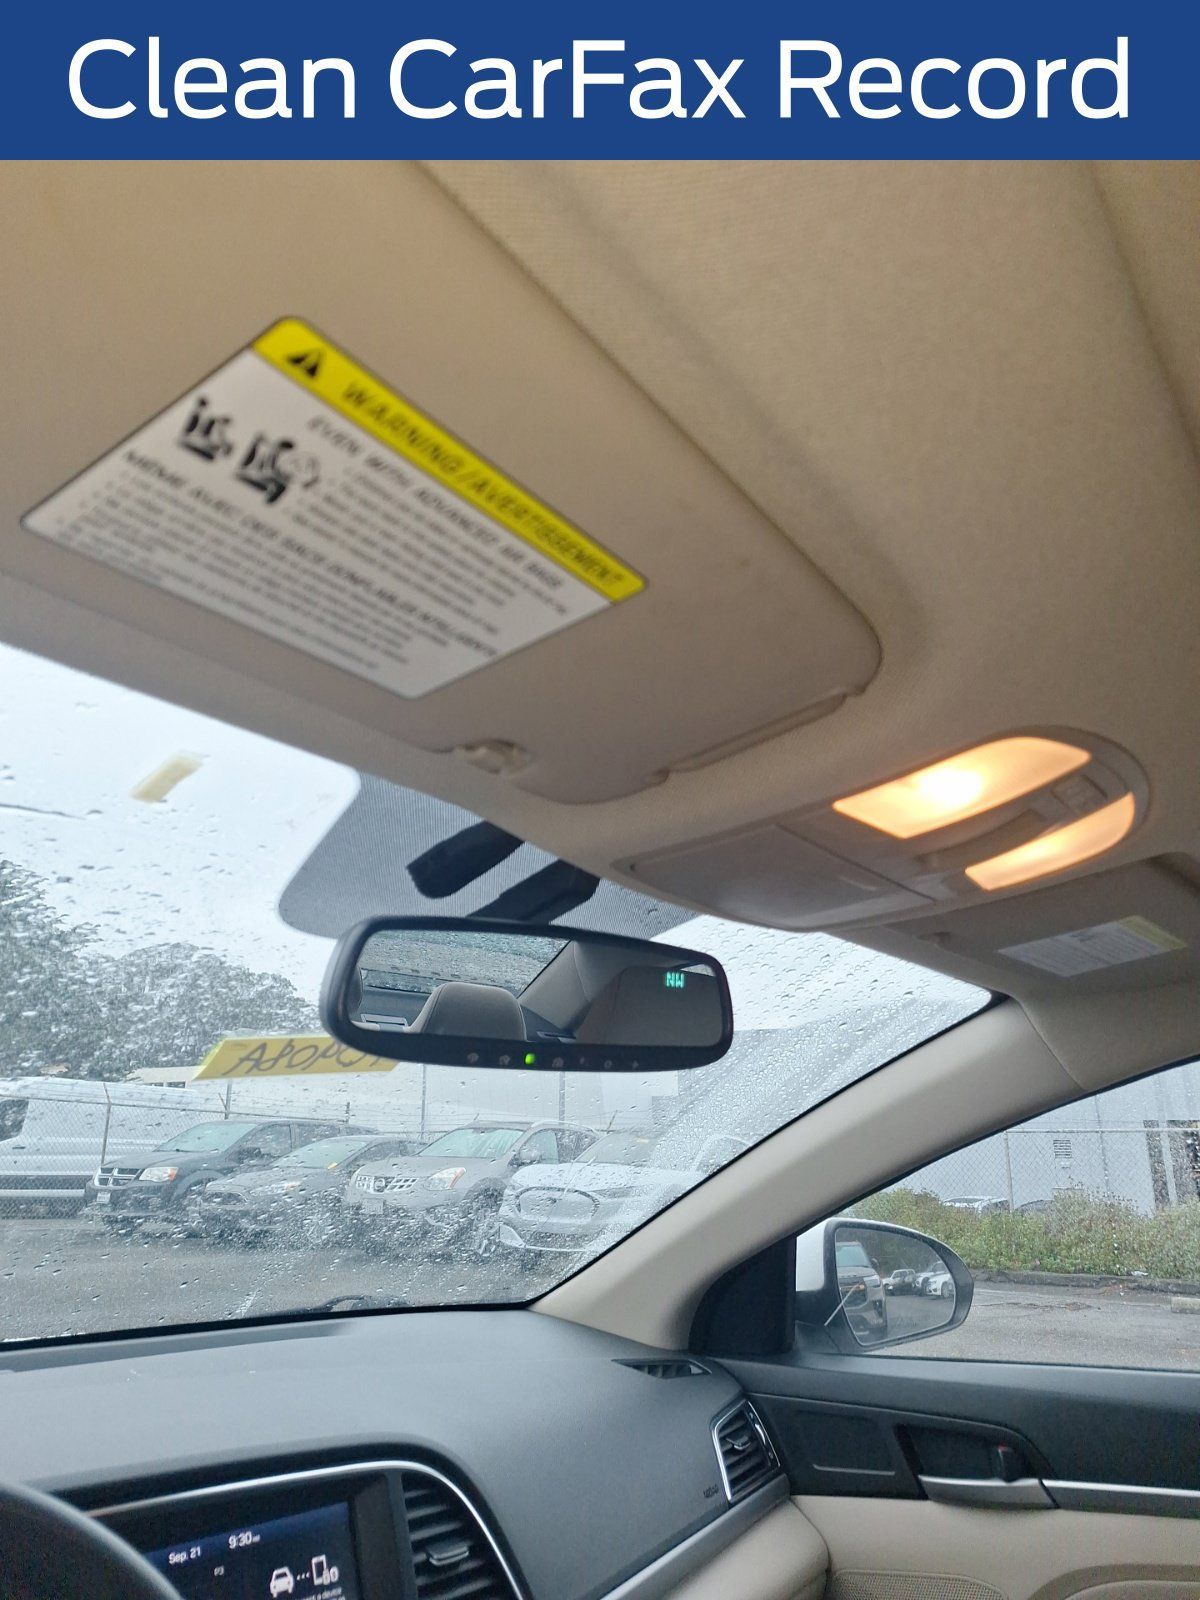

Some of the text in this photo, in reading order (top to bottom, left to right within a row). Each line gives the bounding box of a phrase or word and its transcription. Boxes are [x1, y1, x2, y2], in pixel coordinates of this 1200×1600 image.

[666, 971, 685, 989] NW
[228, 1531, 252, 1549] 9:30
[168, 1546, 201, 1565] Sep. 21
